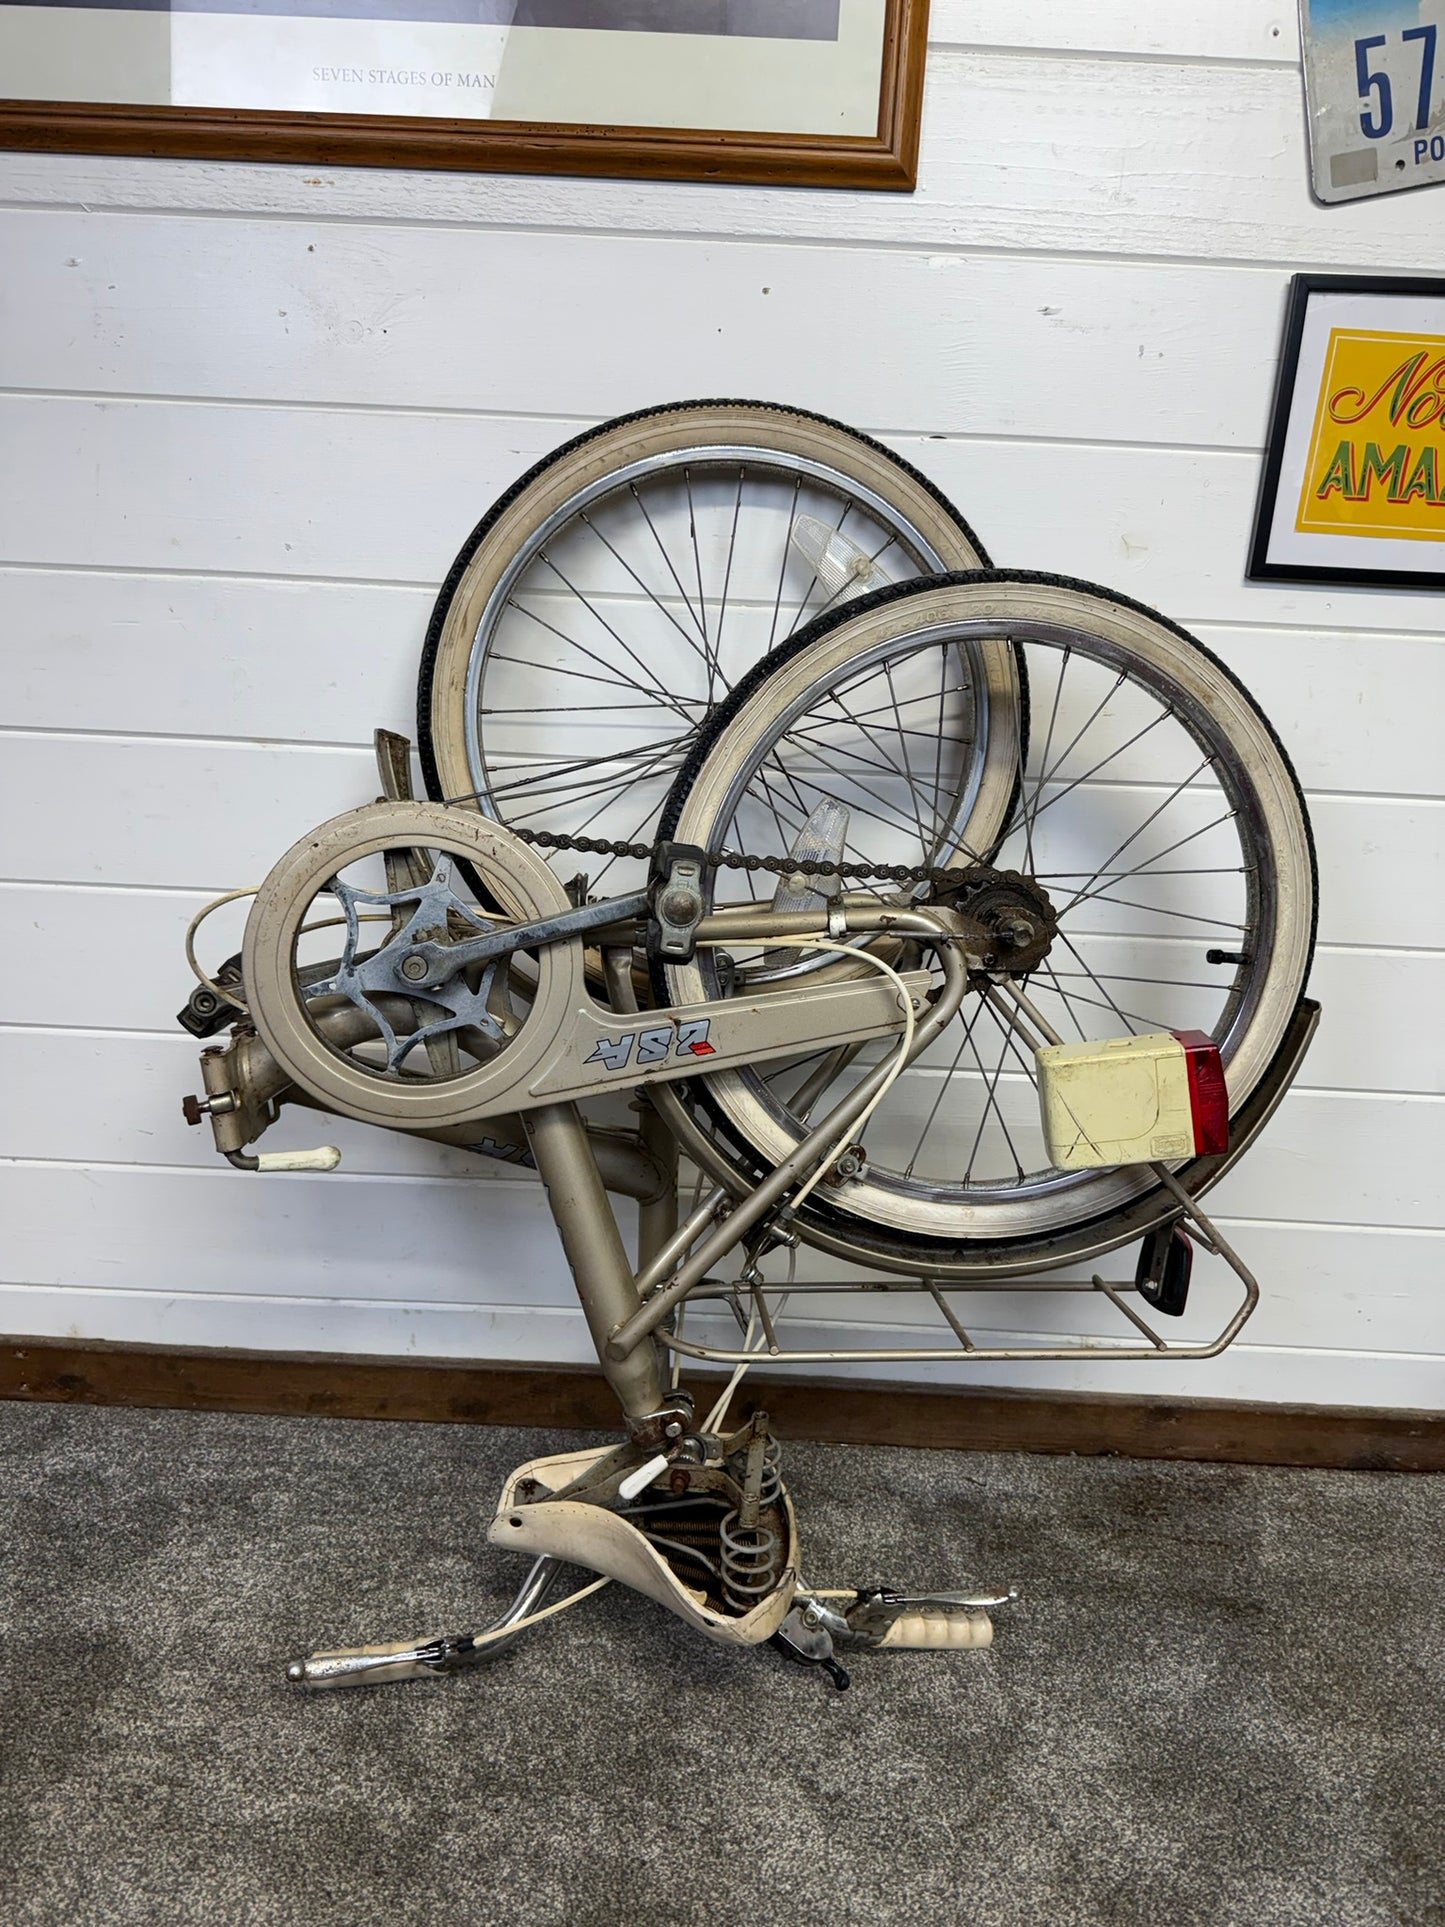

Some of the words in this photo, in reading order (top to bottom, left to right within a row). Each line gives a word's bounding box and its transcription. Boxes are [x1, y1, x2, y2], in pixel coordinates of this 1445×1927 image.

[312, 67, 364, 83] SEVEN
[368, 69, 427, 86] STAGES
[431, 71, 452, 87] OF
[457, 73, 497, 89] MAN
[1355, 24, 1437, 139] 57
[1316, 440, 1445, 507] AMA
